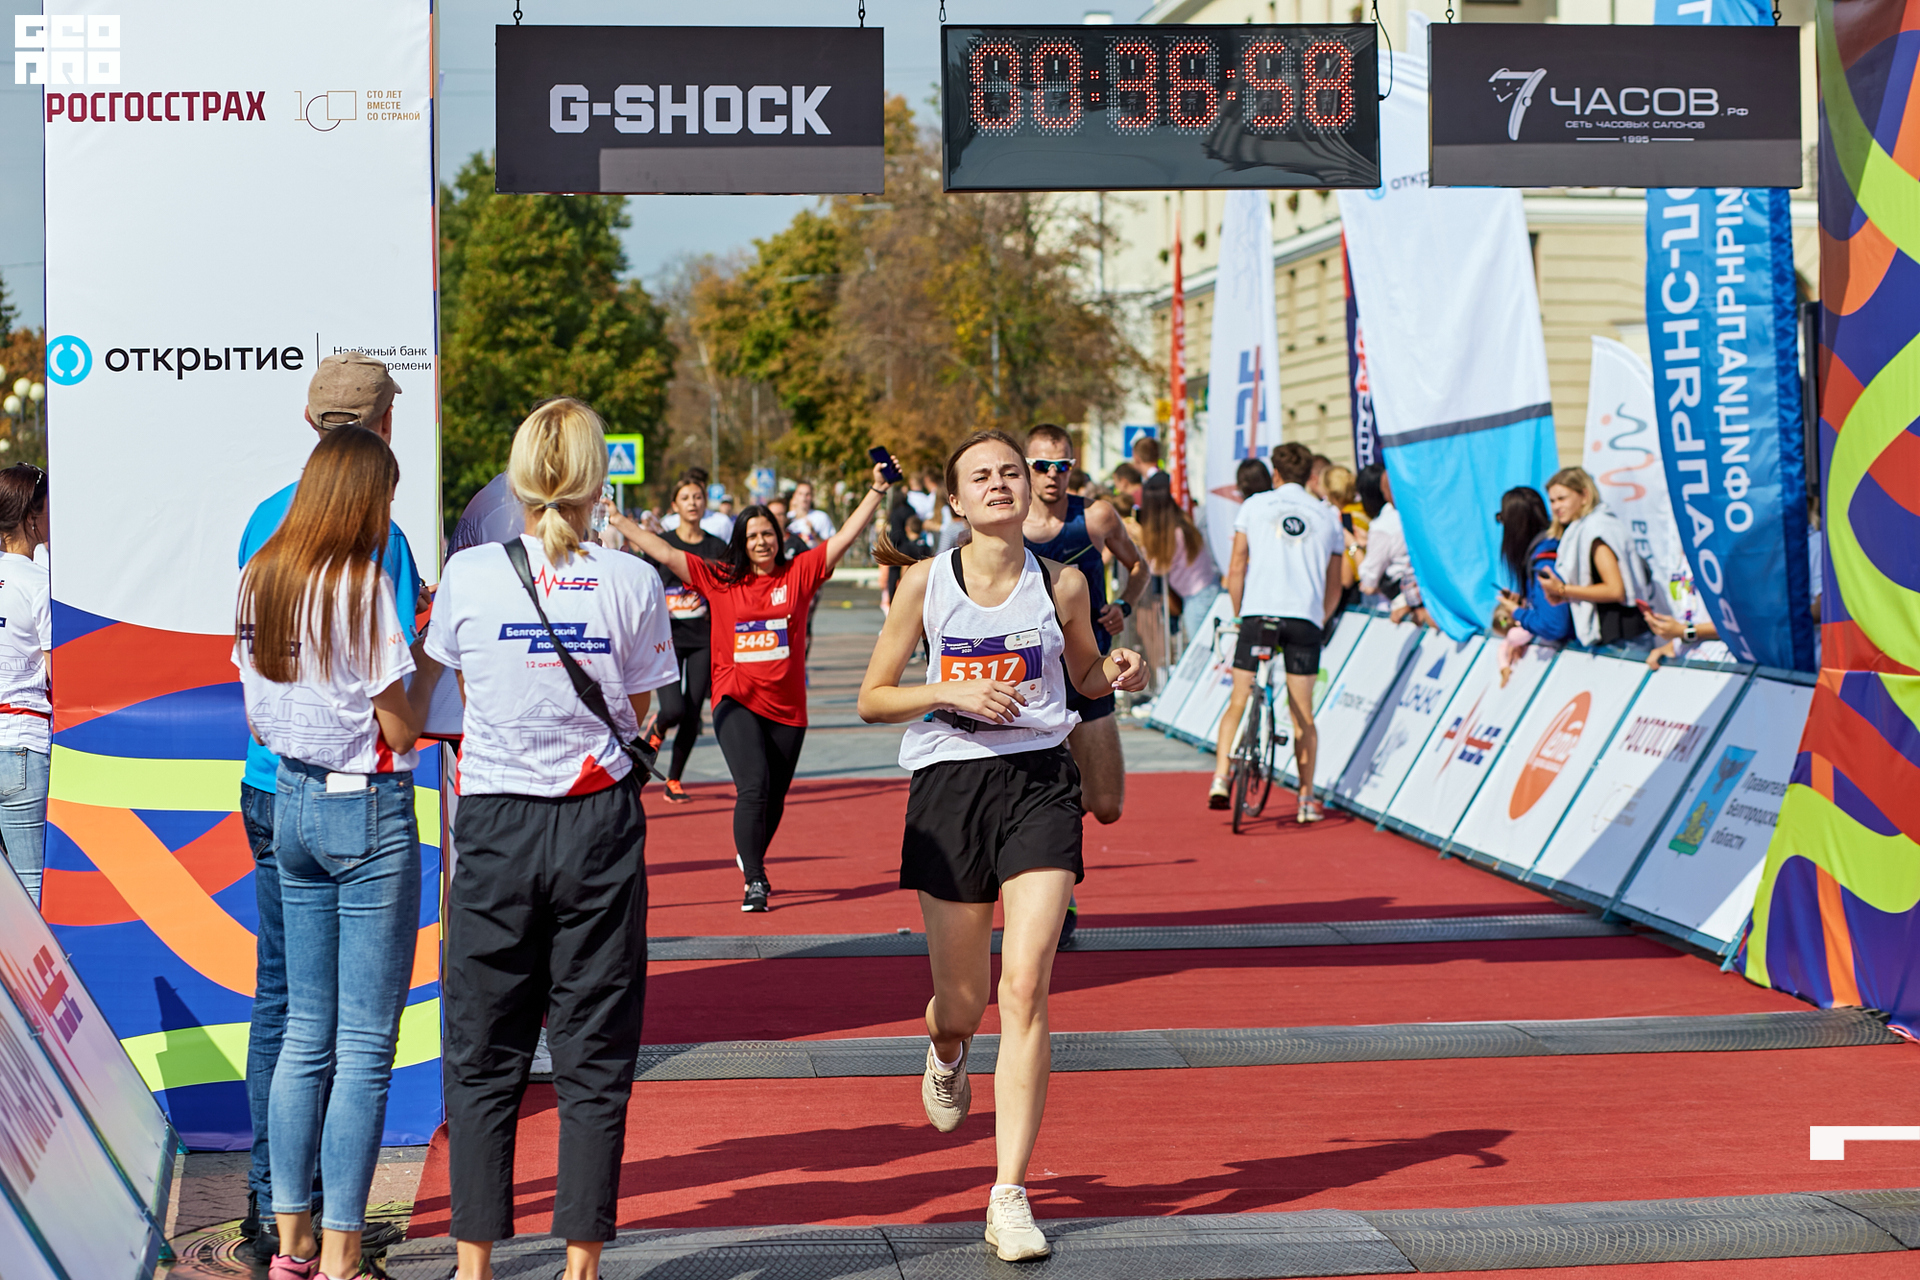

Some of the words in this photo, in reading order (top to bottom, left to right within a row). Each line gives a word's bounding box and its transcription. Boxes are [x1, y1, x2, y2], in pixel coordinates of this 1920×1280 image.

[970, 39, 1354, 132] 00:36:58
[367, 90, 384, 99] СТО
[385, 90, 403, 99] ЛЕТ
[46, 91, 266, 122] РОСГОССТРАХ
[366, 101, 402, 110] ВМЕСТЕ
[550, 85, 831, 134] G-SHOCK
[366, 112, 379, 121] СО
[381, 110, 421, 121] СТРАНОЙ
[1565, 120, 1594, 129] СЕТЬ
[1596, 120, 1650, 129] ЧАСОВЫХ
[1652, 120, 1706, 129] САЛОНОВ
[399, 345, 428, 356] банк
[104, 346, 304, 380] открытие
[505, 626, 578, 638] Белгороский
[536, 640, 606, 651] полмарафон
[736, 632, 775, 650] 5445
[949, 657, 1021, 681] 5317
